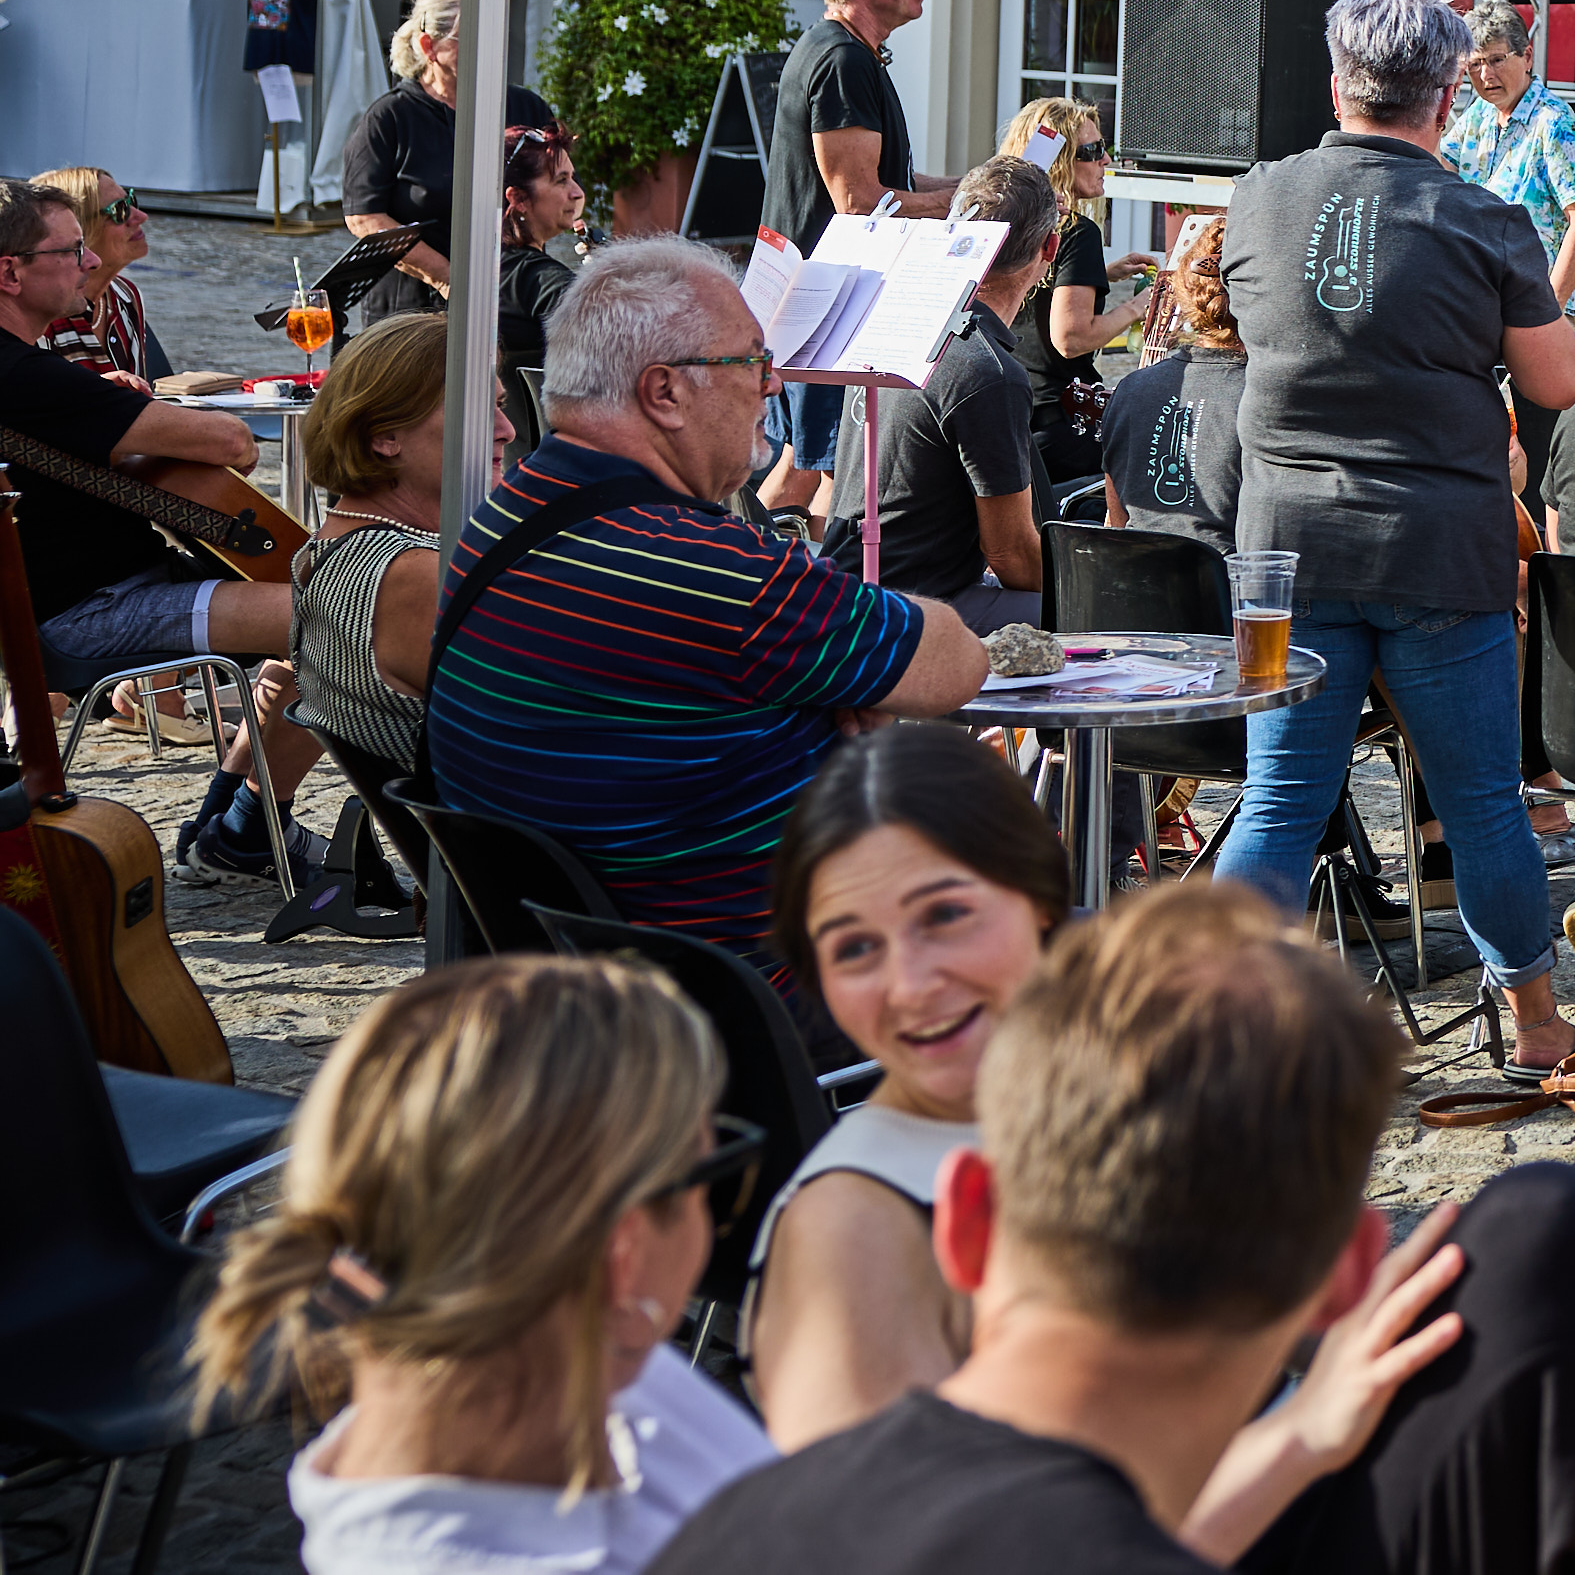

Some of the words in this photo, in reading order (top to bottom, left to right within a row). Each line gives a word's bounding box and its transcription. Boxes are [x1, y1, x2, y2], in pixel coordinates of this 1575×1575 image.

[1304, 192, 1343, 281] ZAUMSPÜN
[1367, 194, 1381, 251] GEWÖHNLICH
[1366, 253, 1375, 285] AUSSER
[1366, 288, 1374, 314] ALLES
